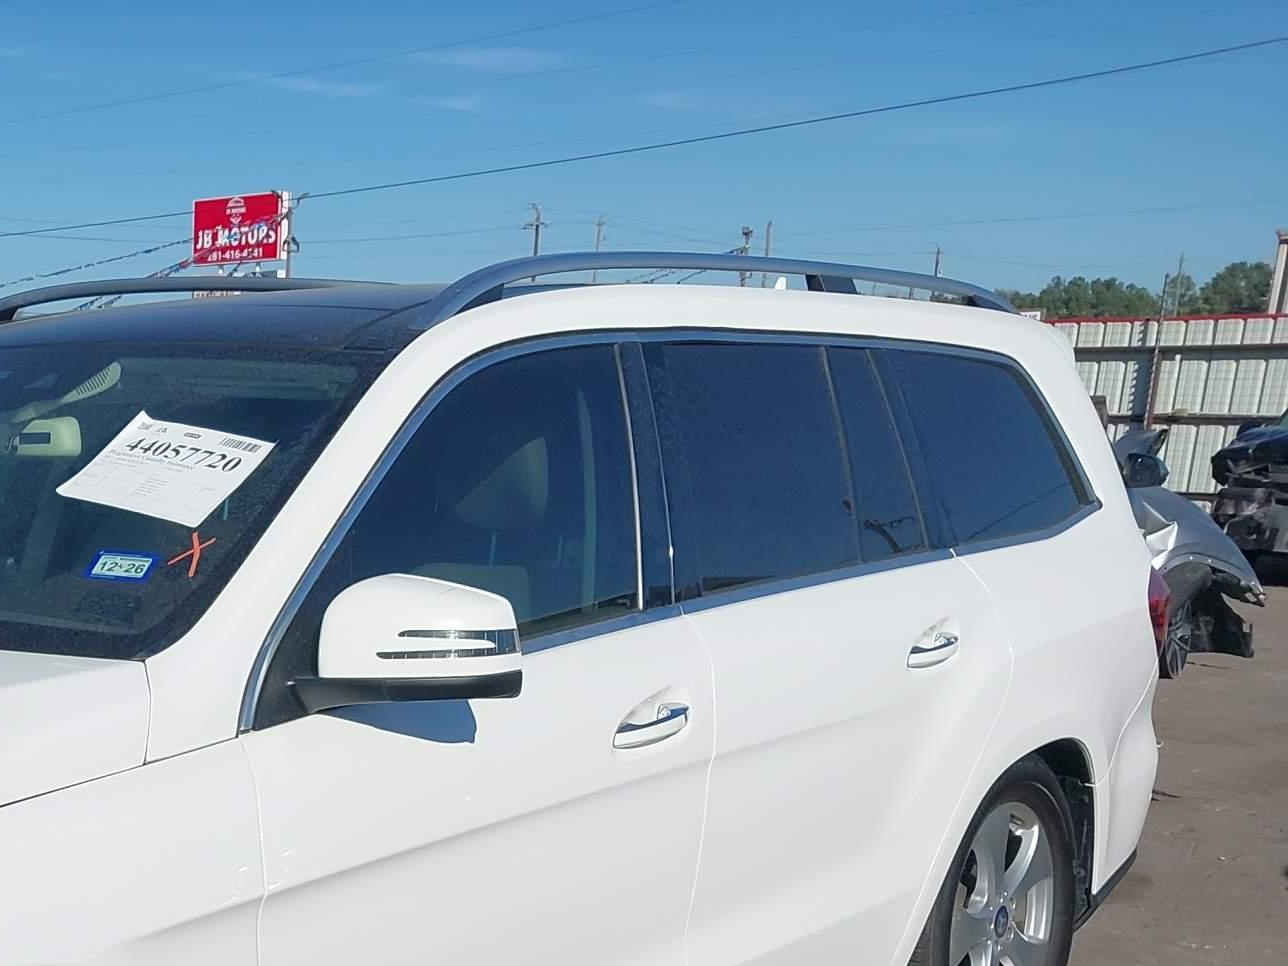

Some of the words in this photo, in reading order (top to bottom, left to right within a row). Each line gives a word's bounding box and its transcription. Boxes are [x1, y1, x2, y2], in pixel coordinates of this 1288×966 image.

[196, 229, 212, 249] JB
[126, 438, 242, 472] 44057720
[99, 561, 118, 572] 12
[123, 563, 146, 574] 26
